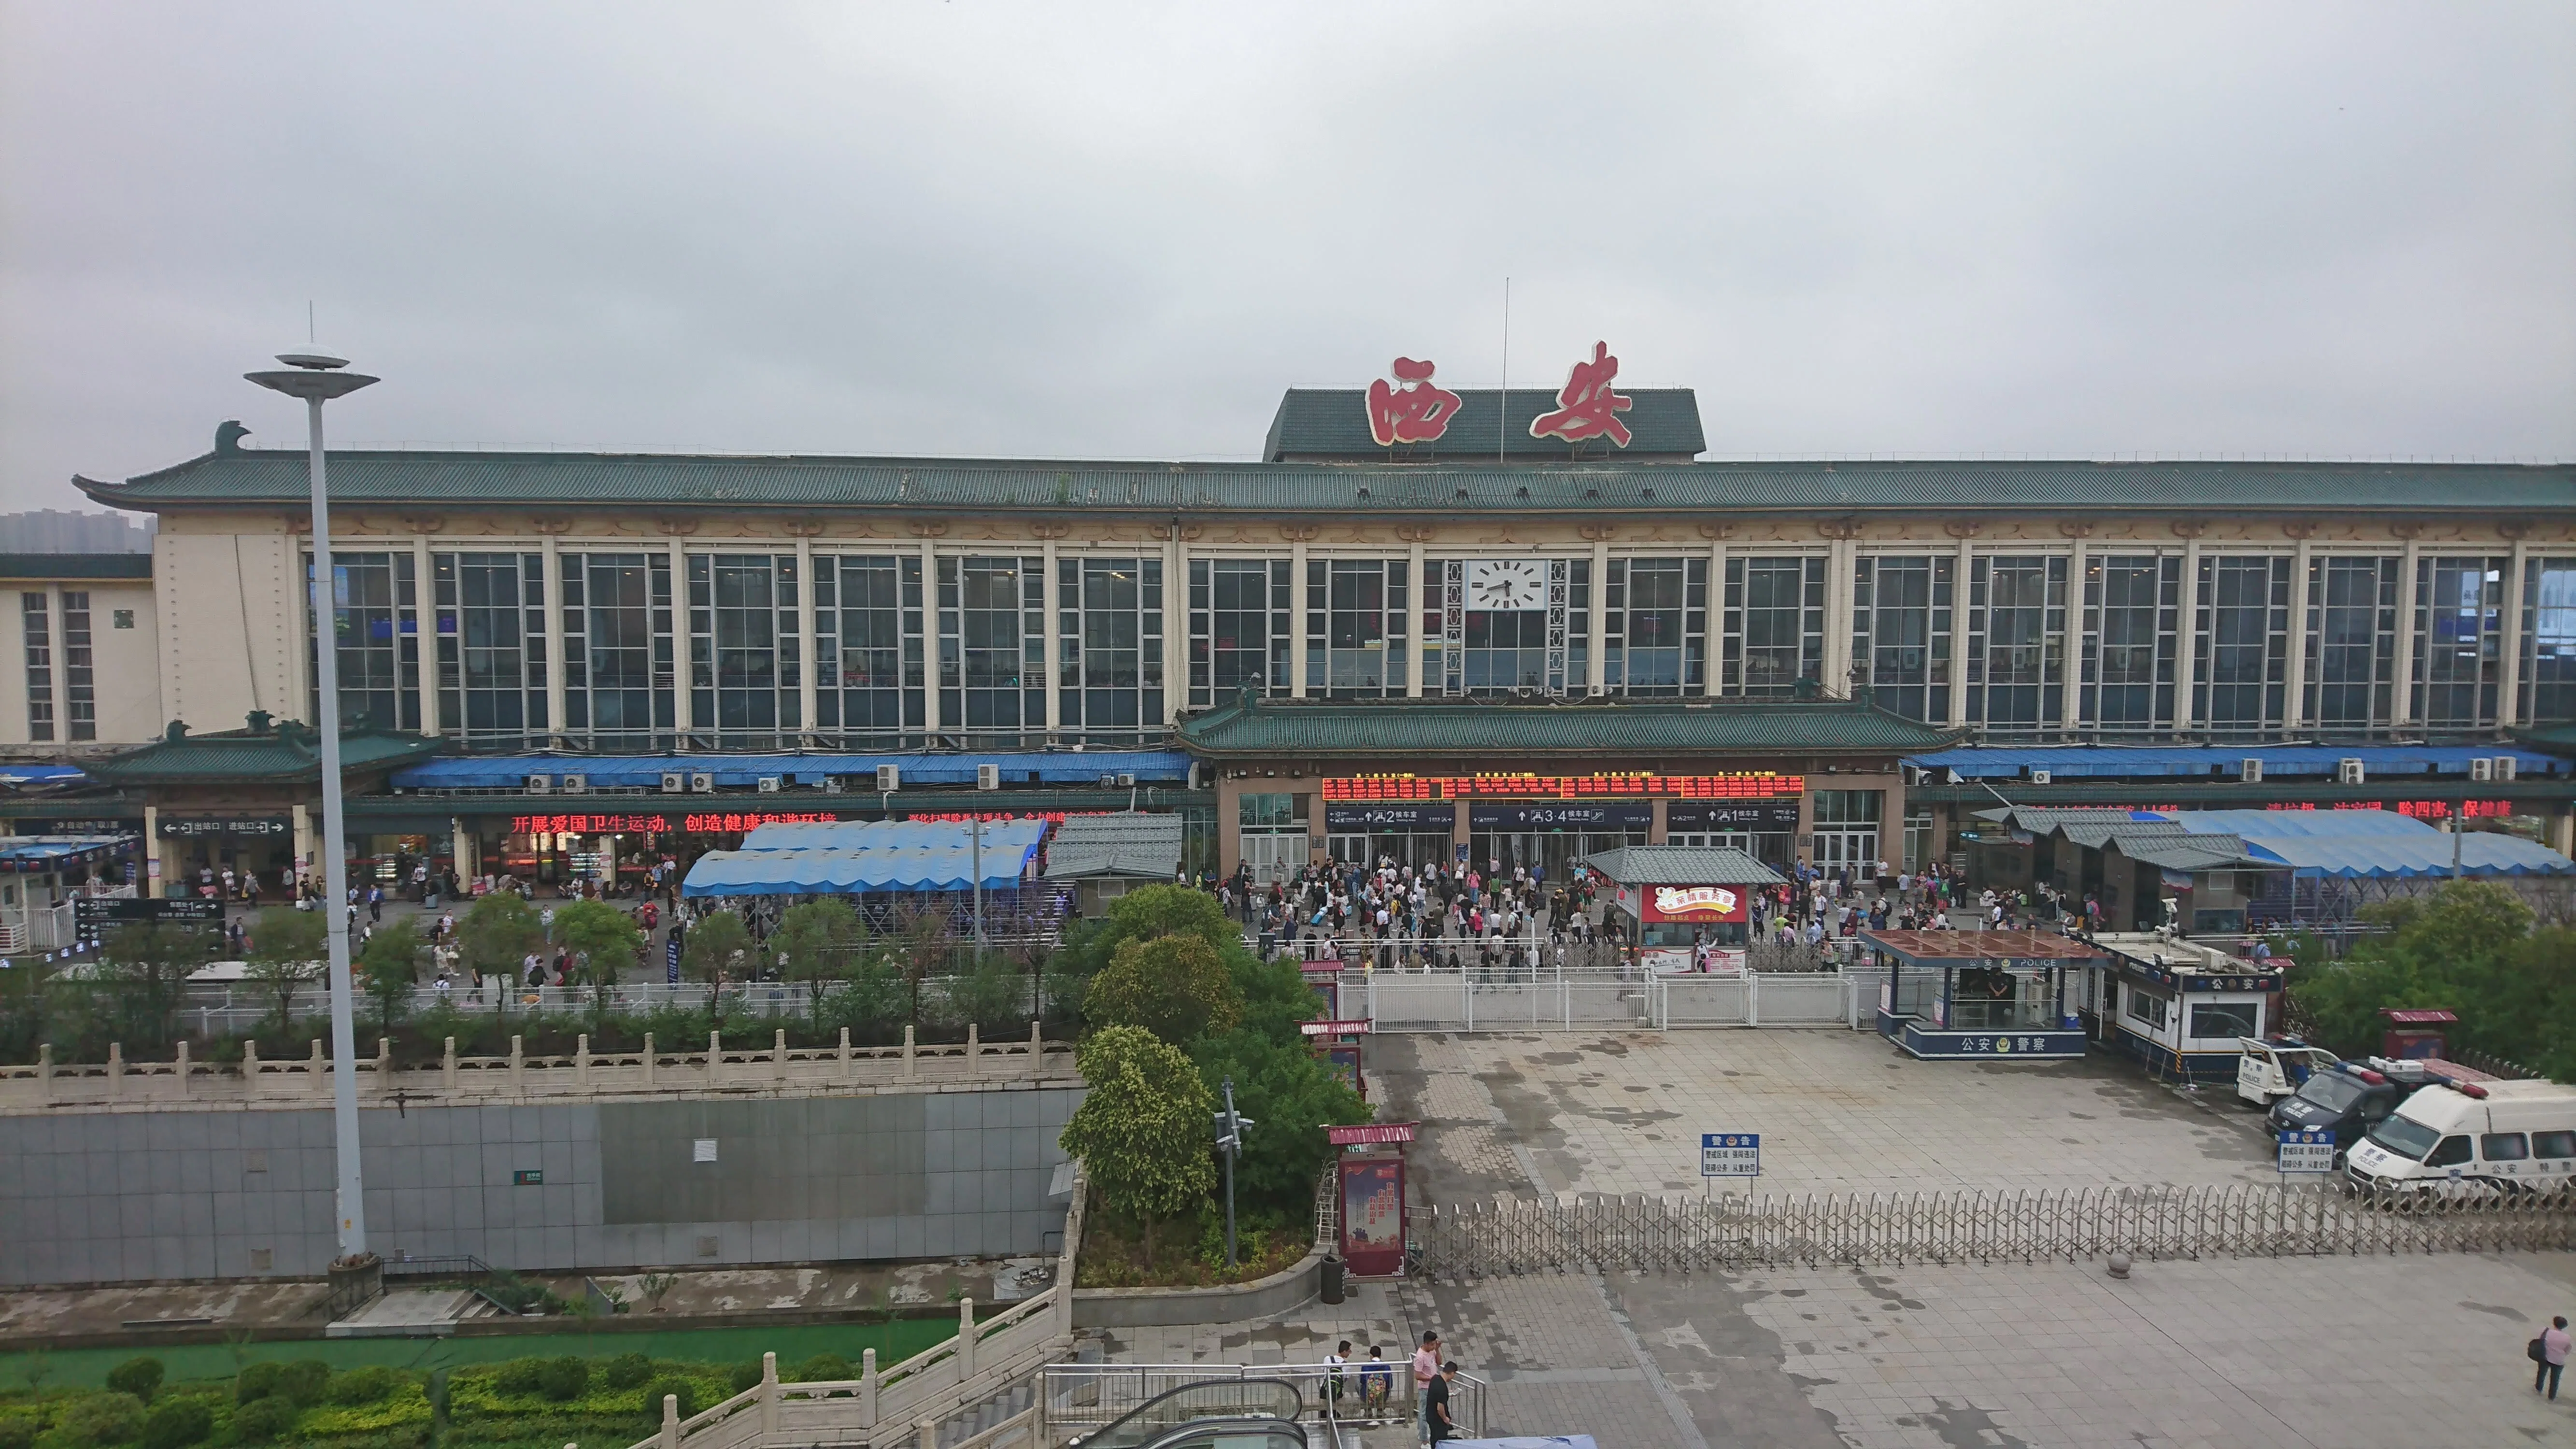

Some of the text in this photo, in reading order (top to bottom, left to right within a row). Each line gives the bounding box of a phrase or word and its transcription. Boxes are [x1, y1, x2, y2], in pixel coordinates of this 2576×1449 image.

[1365, 339, 1632, 448] 西安
[1386, 810, 1395, 822] 2
[1731, 810, 1737, 821] 1
[194, 822, 254, 830] 出站口 进站口
[189, 901, 193, 912] 1
[1962, 1037, 2045, 1051] 公安 警察
[2243, 1072, 2261, 1084] POLICE
[1711, 1136, 1751, 1146] 警 告
[2289, 1132, 2327, 1143] 警 告
[1706, 1150, 1755, 1158] 警戒区域 强闯违法
[2363, 1148, 2388, 1162] 警察
[2357, 1154, 2379, 1168] POLICE
[1705, 1164, 1755, 1172] 阻碍公务 从重处罚
[2491, 1164, 2517, 1174] 公安
